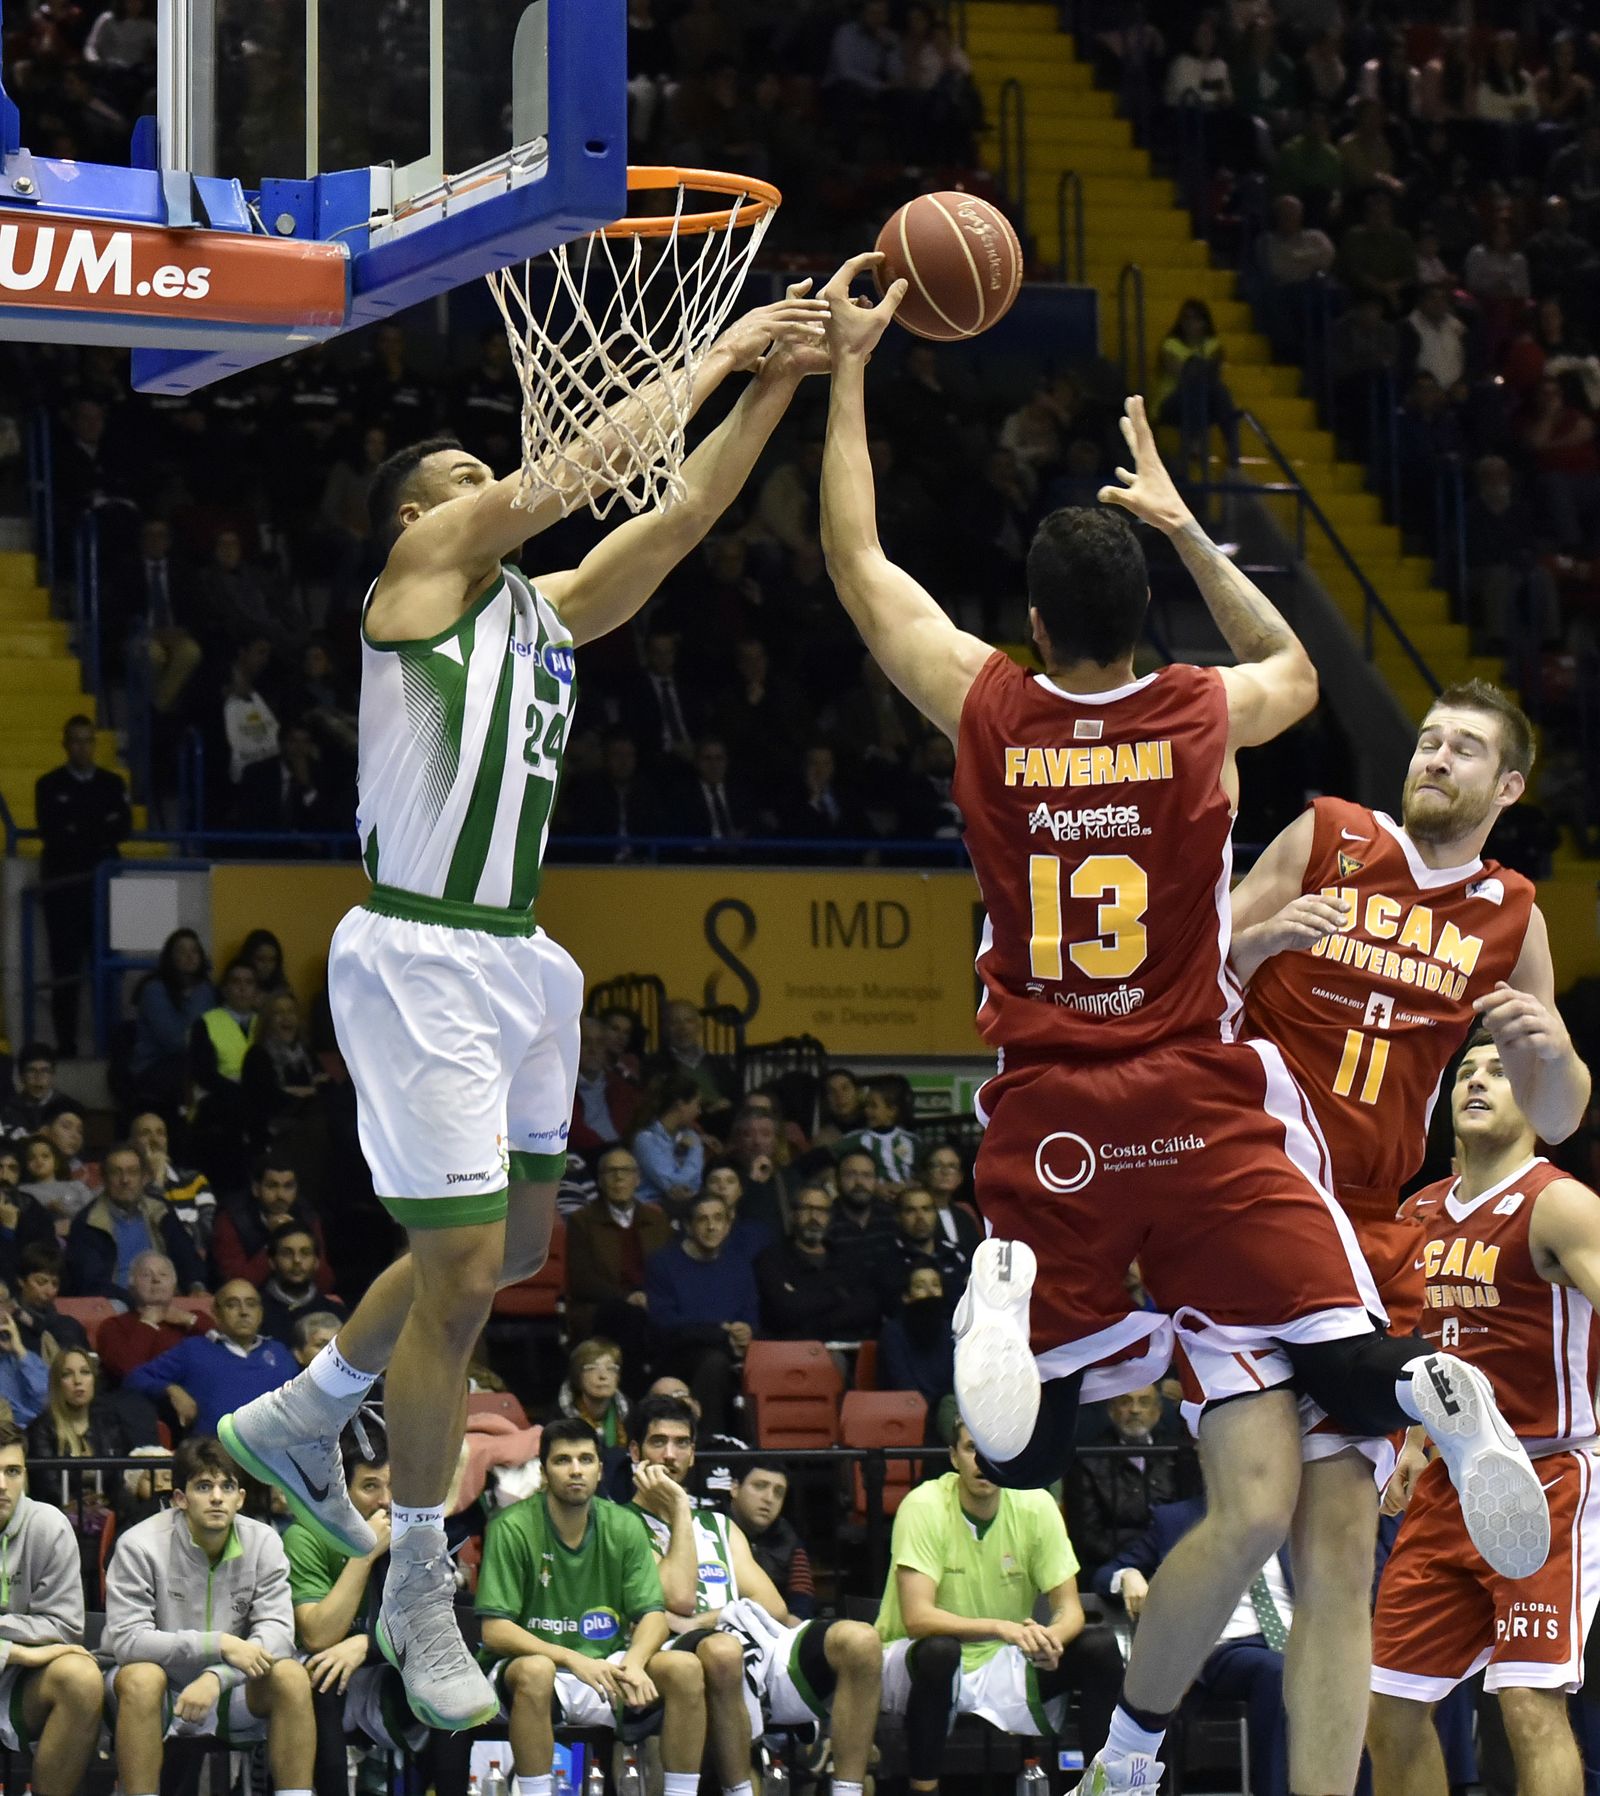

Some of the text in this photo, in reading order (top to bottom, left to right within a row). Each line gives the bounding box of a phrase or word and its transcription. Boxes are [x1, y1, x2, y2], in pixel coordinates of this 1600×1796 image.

[523, 703, 566, 768] 24
[1004, 740, 1174, 787] FAVERANI
[1028, 802, 1140, 841] Apuestas
[1060, 826, 1081, 841] de
[810, 900, 911, 949] IMD
[1029, 854, 1148, 981] 13
[1311, 933, 1469, 1002] UNIVERSIDAD
[1054, 984, 1145, 1018] Murcia
[1311, 986, 1348, 1005] CARAVACA
[1347, 998, 1365, 1010] 2017
[1331, 1028, 1391, 1105] 11
[1100, 1133, 1206, 1159] Costa Cálida
[446, 1170, 490, 1185] SPALDING
[1103, 1157, 1178, 1172] Región de Murcia
[698, 1565, 725, 1579] plus
[1513, 1602, 1559, 1614] GLOBAL
